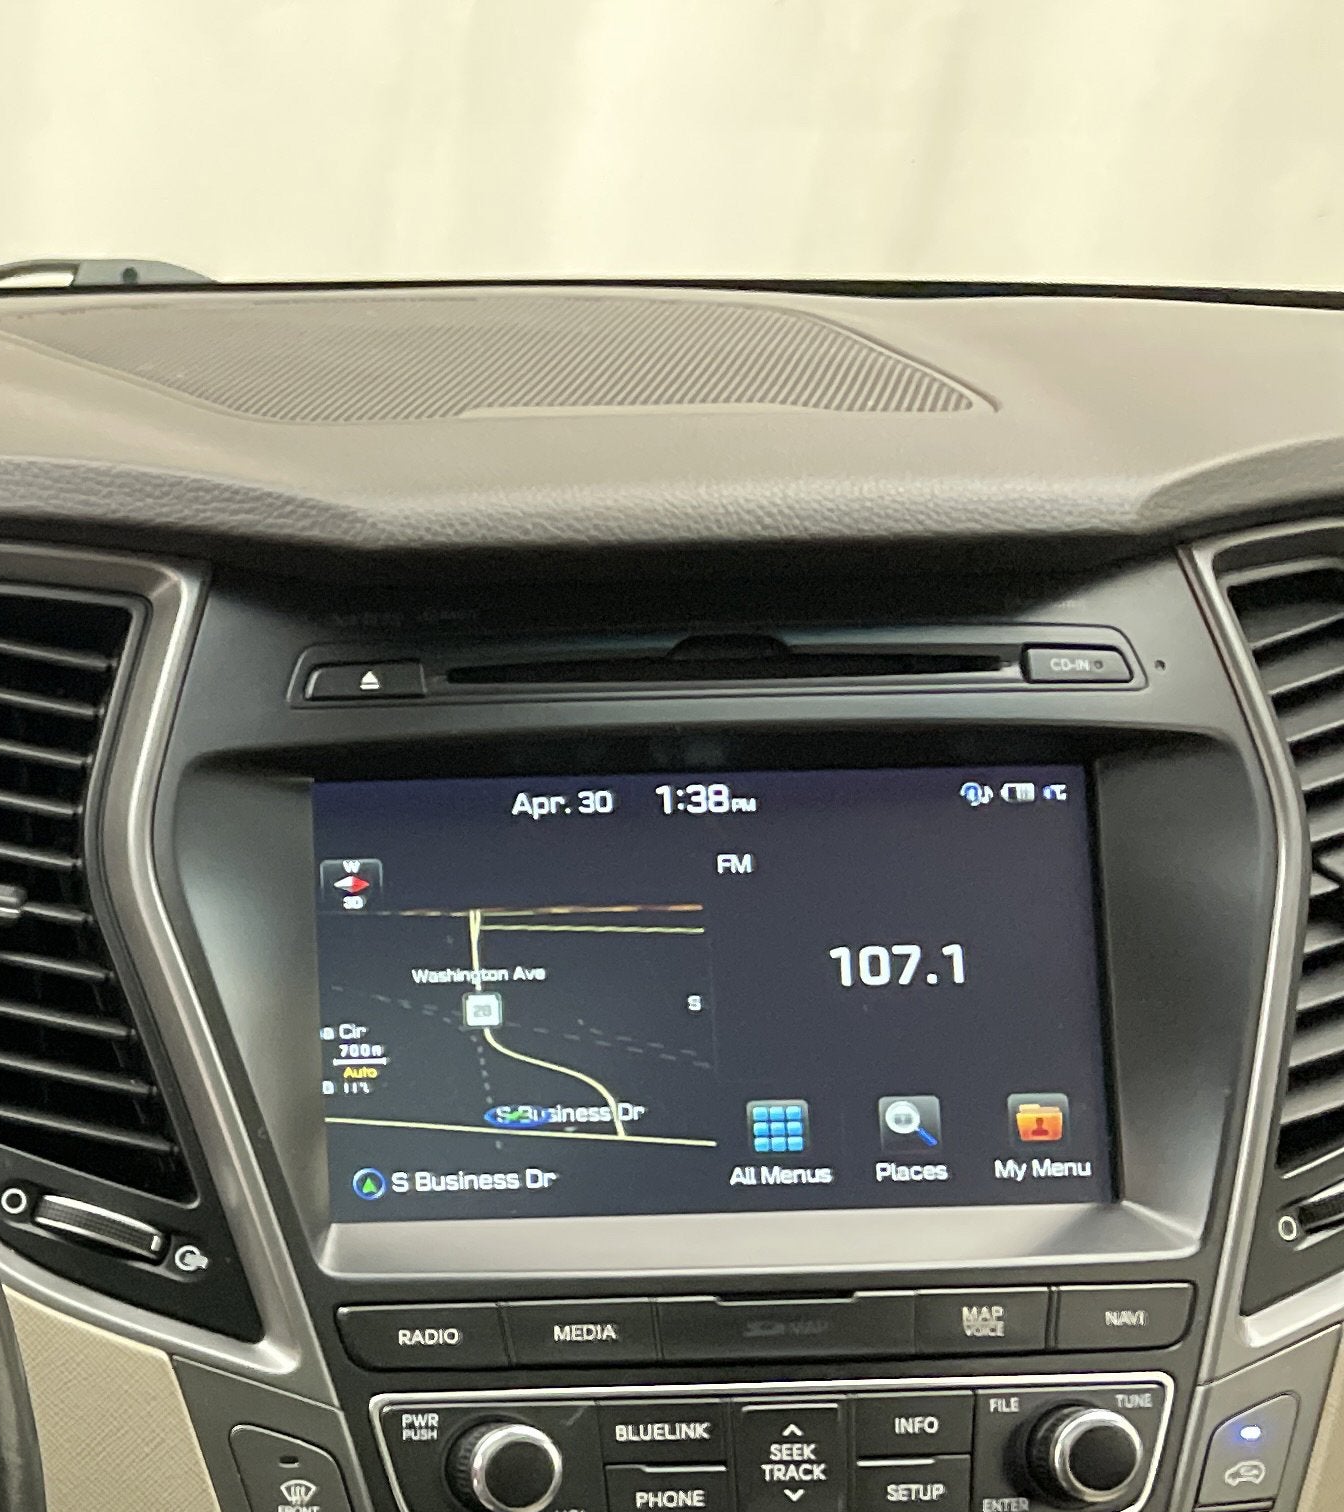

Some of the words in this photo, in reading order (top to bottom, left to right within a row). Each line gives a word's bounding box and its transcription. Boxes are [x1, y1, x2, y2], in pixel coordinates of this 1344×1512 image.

[511, 792, 571, 820] Apr.
[578, 790, 613, 814] 30
[717, 853, 753, 875] FM
[829, 943, 966, 987] 107.1
[412, 968, 509, 986] Washington
[513, 966, 546, 981] Ave
[343, 1066, 379, 1078] Auto
[617, 1102, 645, 1121] Dr
[729, 1166, 757, 1187] All
[760, 1165, 833, 1186] Menus
[875, 1162, 948, 1182] Places
[994, 1159, 1026, 1182] My
[1031, 1159, 1091, 1179] Menu
[391, 1171, 409, 1193] S
[416, 1169, 520, 1192] Business
[525, 1168, 558, 1189] Dr
[962, 1306, 1005, 1322] MAP
[1105, 1310, 1149, 1327] NAVI
[398, 1328, 461, 1346] RADIO
[553, 1324, 619, 1343] MEDIA
[989, 1398, 1019, 1413] FILE
[1116, 1394, 1152, 1410] TUNE
[402, 1414, 438, 1429] PWR
[895, 1416, 939, 1434] INFO
[402, 1428, 438, 1441] PUSH
[615, 1422, 710, 1442] BLUELINK
[770, 1443, 817, 1461] SEEK
[760, 1463, 827, 1481] TRACK
[635, 1490, 706, 1509] PHONE
[886, 1484, 945, 1502] SETUP
